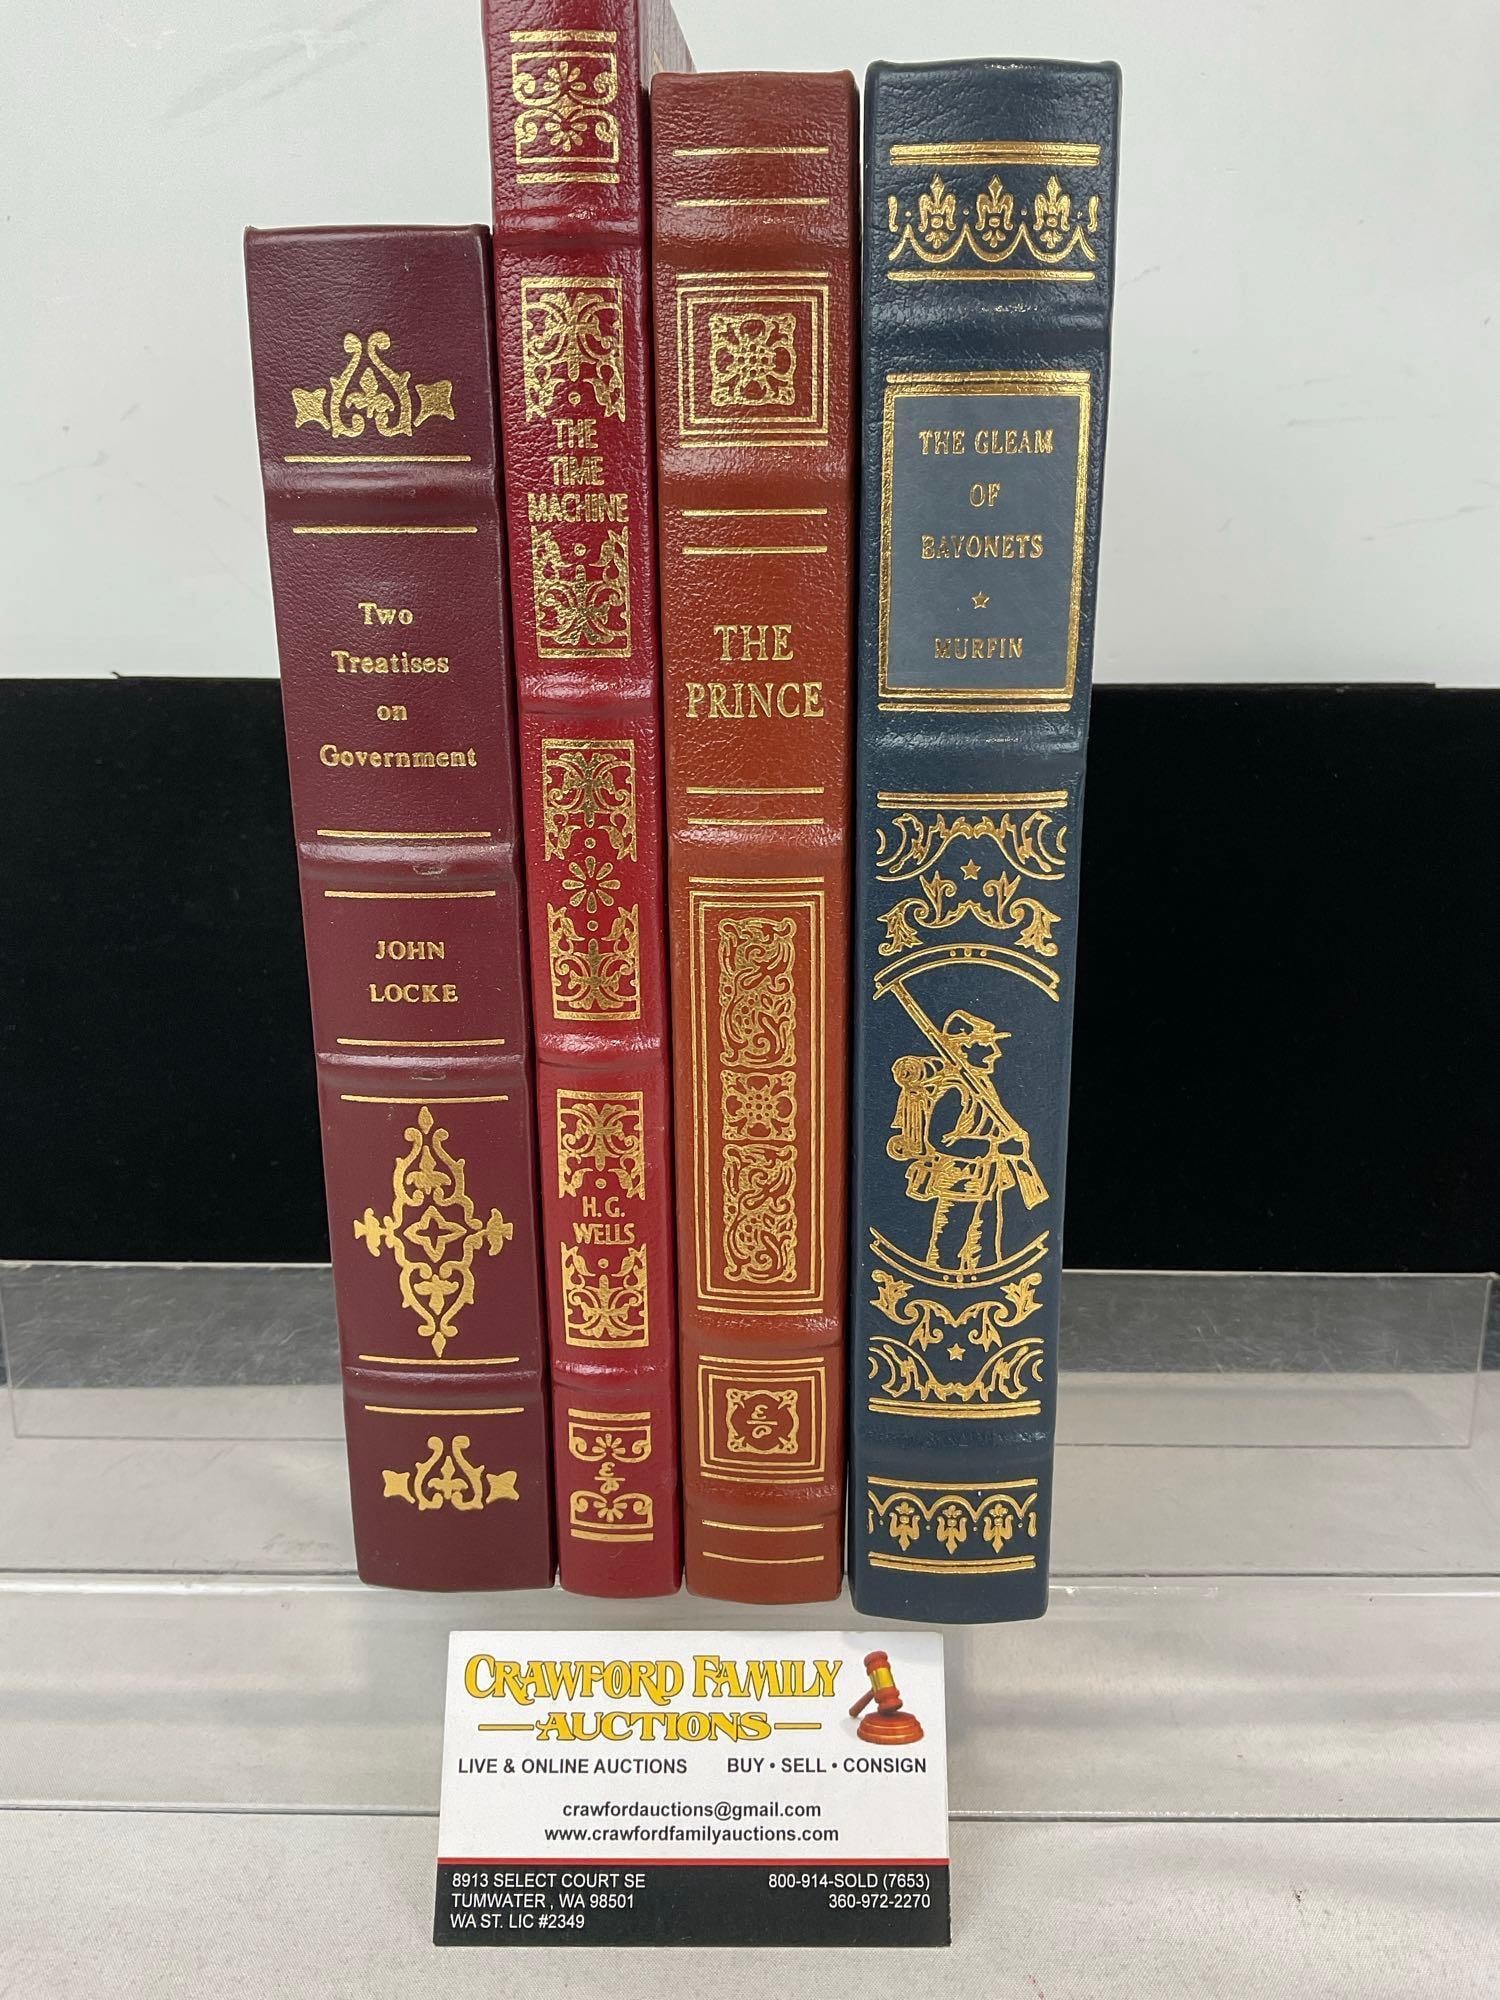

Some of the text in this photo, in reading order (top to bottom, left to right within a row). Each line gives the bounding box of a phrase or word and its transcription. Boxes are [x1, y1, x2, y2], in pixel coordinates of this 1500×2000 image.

[552, 418, 598, 448] THE
[919, 428, 1053, 455] THE GLEAM
[547, 456, 605, 485] TIME
[969, 482, 1000, 507] OF
[527, 492, 629, 522] MACHINE
[921, 534, 1044, 559] BAYONETS
[358, 602, 413, 626] Two
[713, 624, 795, 662] THE
[934, 637, 1023, 660] MURFIN
[331, 651, 450, 674] Treatises
[686, 681, 825, 719] PRINCE
[376, 703, 409, 722] on
[319, 743, 478, 768] Government
[375, 940, 446, 960] JOHN
[368, 983, 459, 1004] LOCKE
[573, 1222, 636, 1245] WELLS
[464, 1654, 843, 1706] CRAWFORD FAMILY
[536, 1711, 771, 1742] AUCTIONS
[458, 1758, 687, 1774] LIVE & ONLINE AUCTIONS
[727, 1757, 927, 1773] BUY SELL CONSIGN
[562, 1801, 821, 1821] crawfordauctions@gmail.com
[545, 1825, 839, 1845] www.crawfordfamilyauctions.com
[452, 1873, 646, 1888] 8913 SELECT COURT SE
[768, 1873, 931, 1891] 800-914-SOLD (7653)
[559, 1893, 585, 1909] WA
[589, 1893, 634, 1909] 98501
[828, 1893, 931, 1909] 360-972-2270
[450, 1913, 585, 1929] WA ST. LIC #2349
